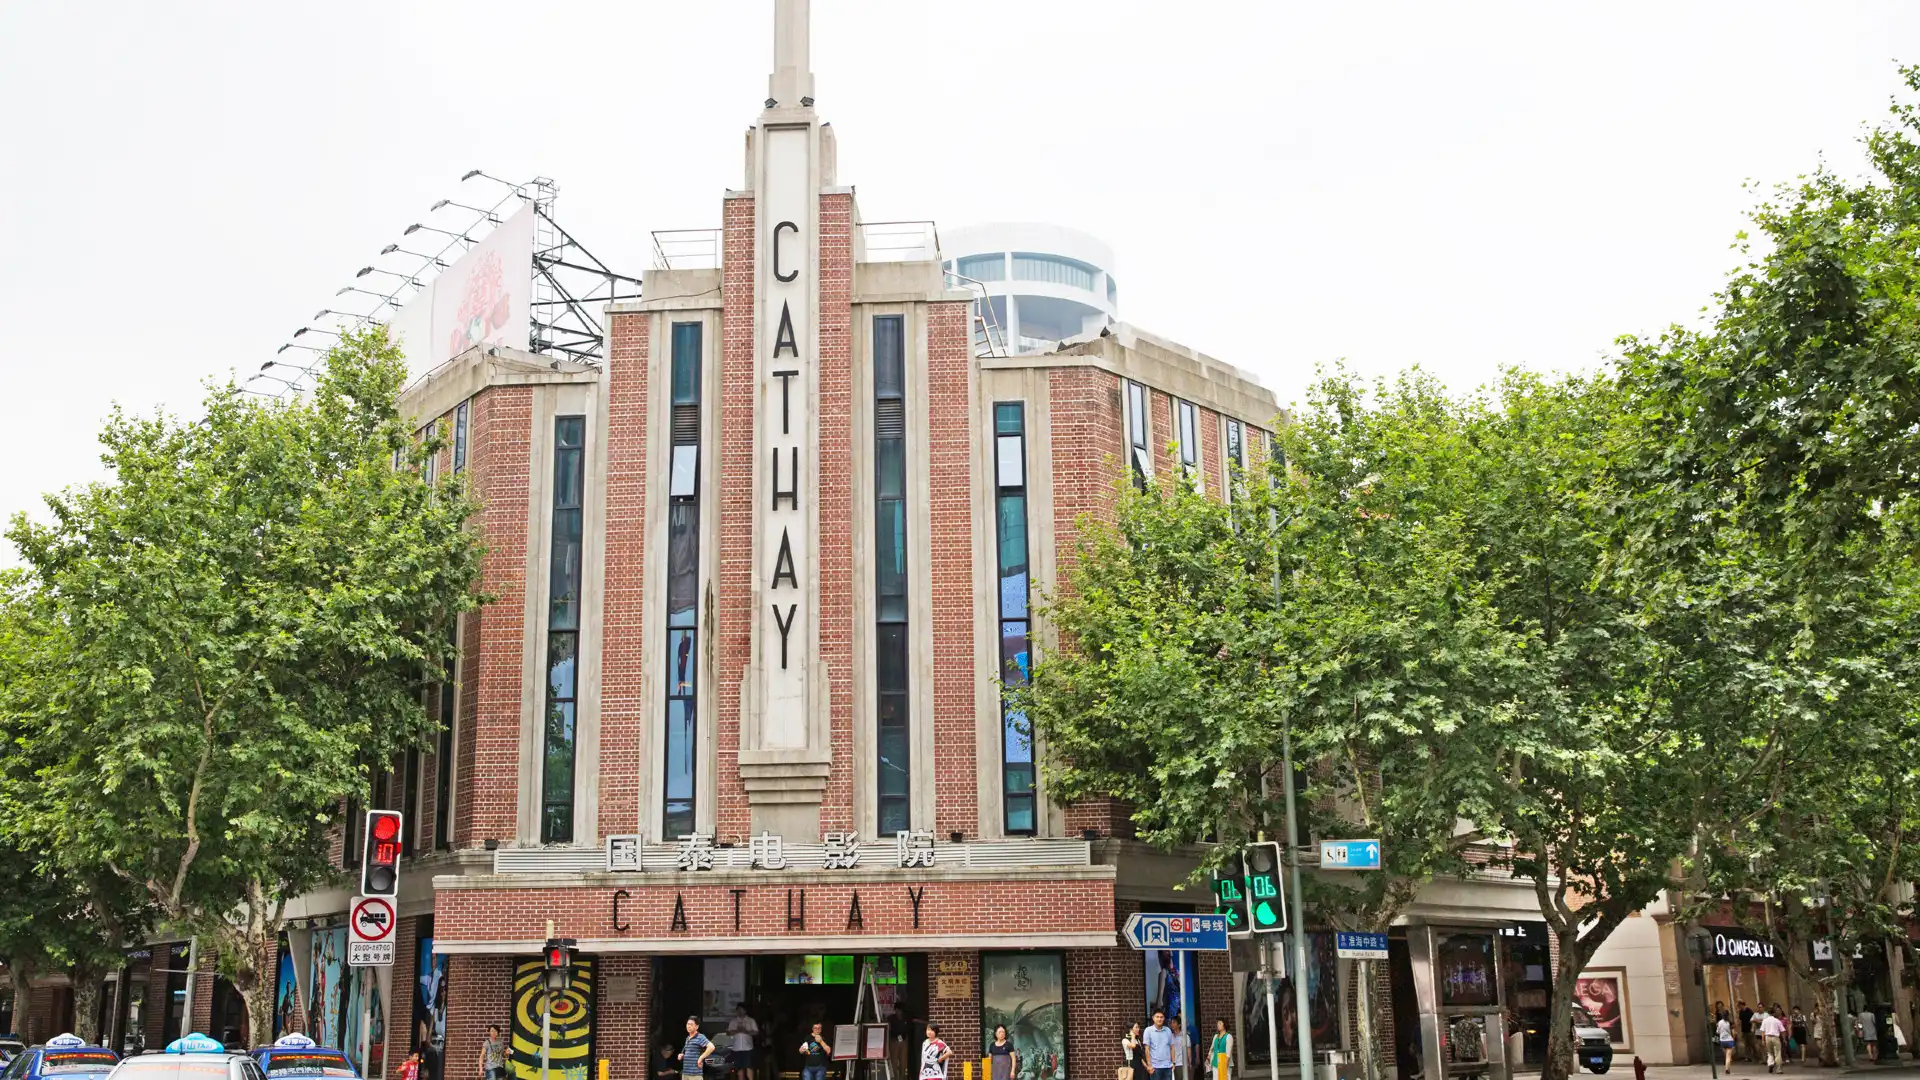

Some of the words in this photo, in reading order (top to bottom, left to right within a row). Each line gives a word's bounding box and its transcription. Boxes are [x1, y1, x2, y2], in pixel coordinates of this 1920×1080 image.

[772, 220, 799, 670] CATHAY
[377, 843, 394, 863] 10
[605, 829, 935, 873] 国泰电影院
[1254, 875, 1277, 897] 06
[612, 886, 924, 932] CATHAY
[1200, 919, 1224, 932] 号线
[1348, 935, 1377, 948] 淮海中路
[1728, 938, 1763, 958] OMEGA
[352, 953, 391, 962] 大型号牌
[1575, 981, 1614, 996] EGA
